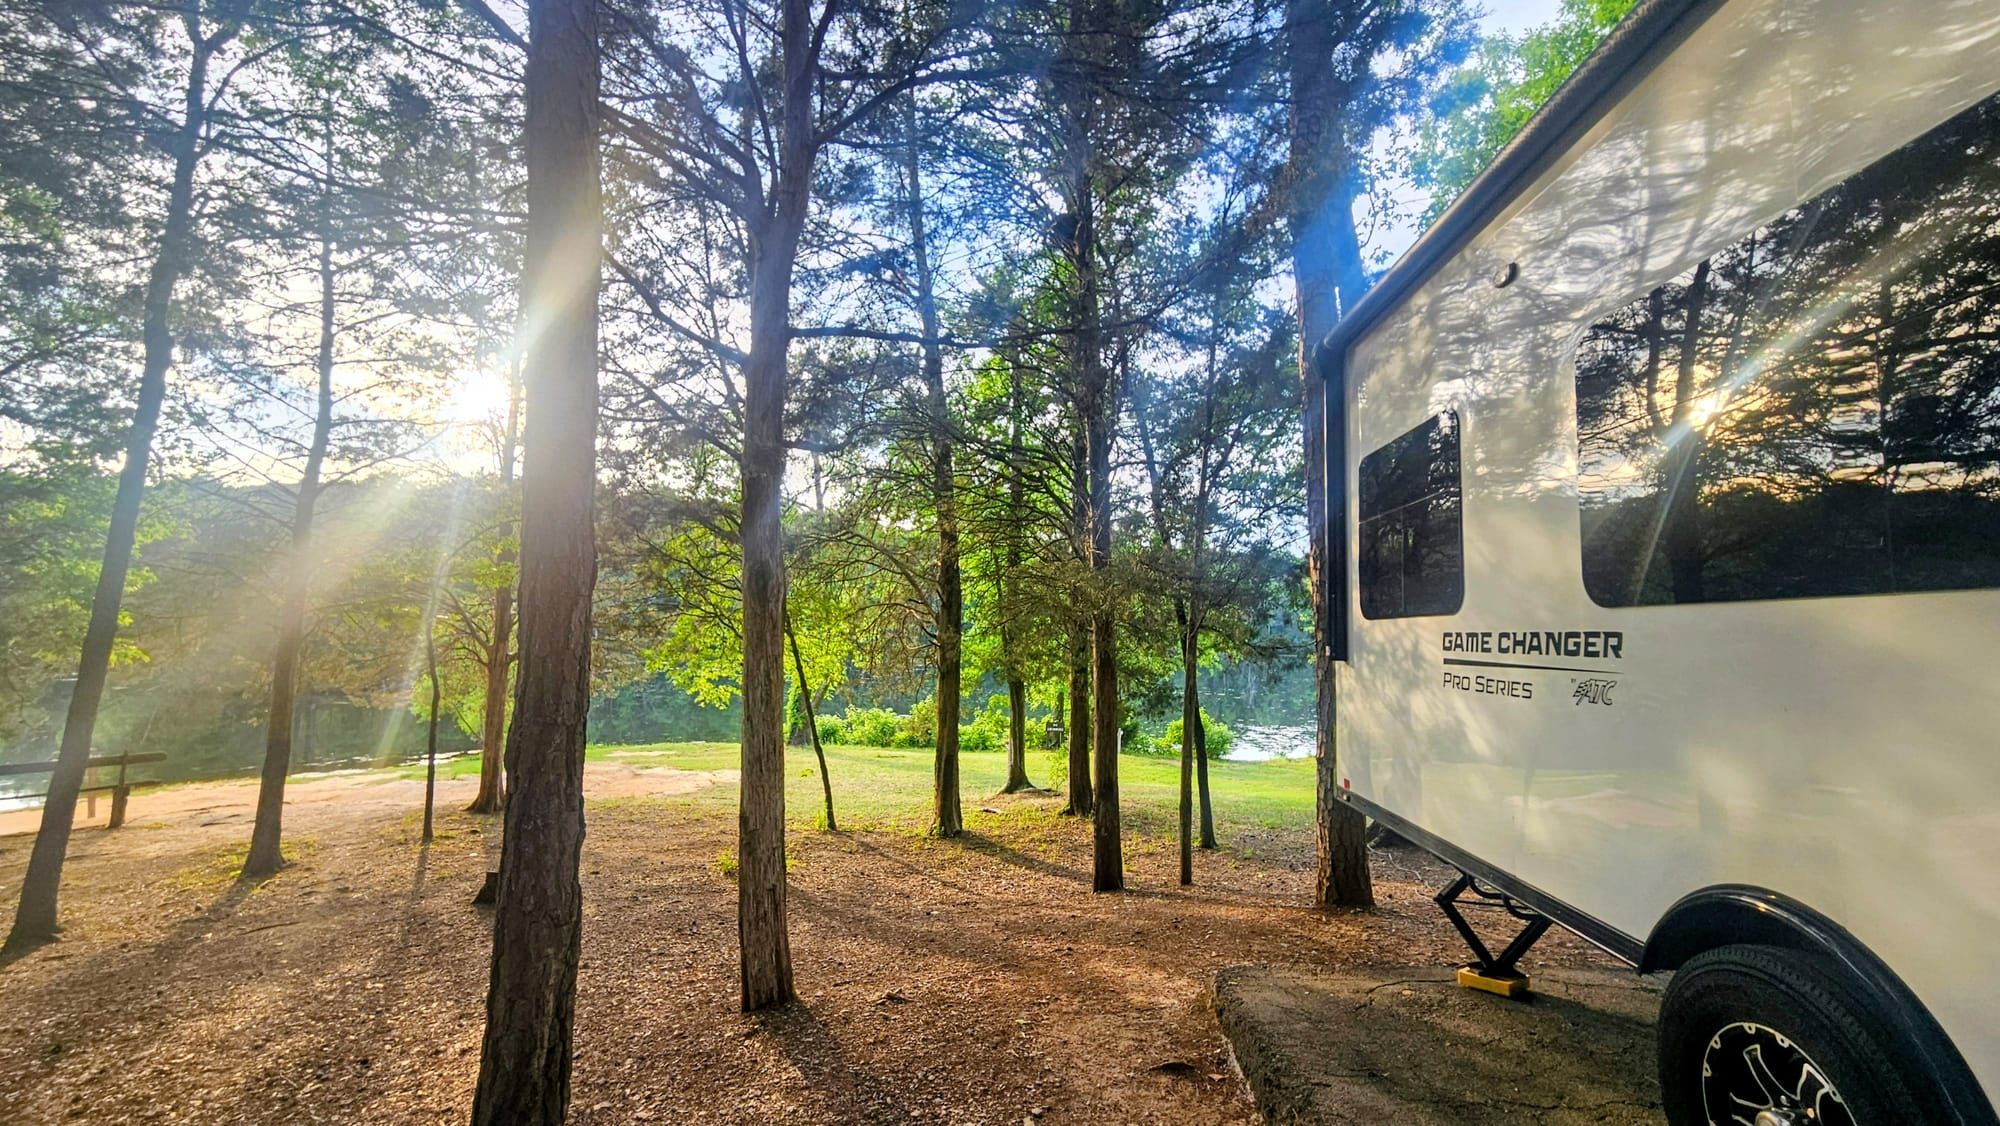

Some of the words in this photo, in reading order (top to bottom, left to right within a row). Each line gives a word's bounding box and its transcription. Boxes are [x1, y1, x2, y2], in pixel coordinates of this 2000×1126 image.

[1442, 632, 1492, 653] GAME
[1498, 631, 1623, 659] CHANGER
[1442, 672, 1471, 691] PRO
[1475, 675, 1533, 699] SERIES
[1573, 678, 1617, 705] ATC
